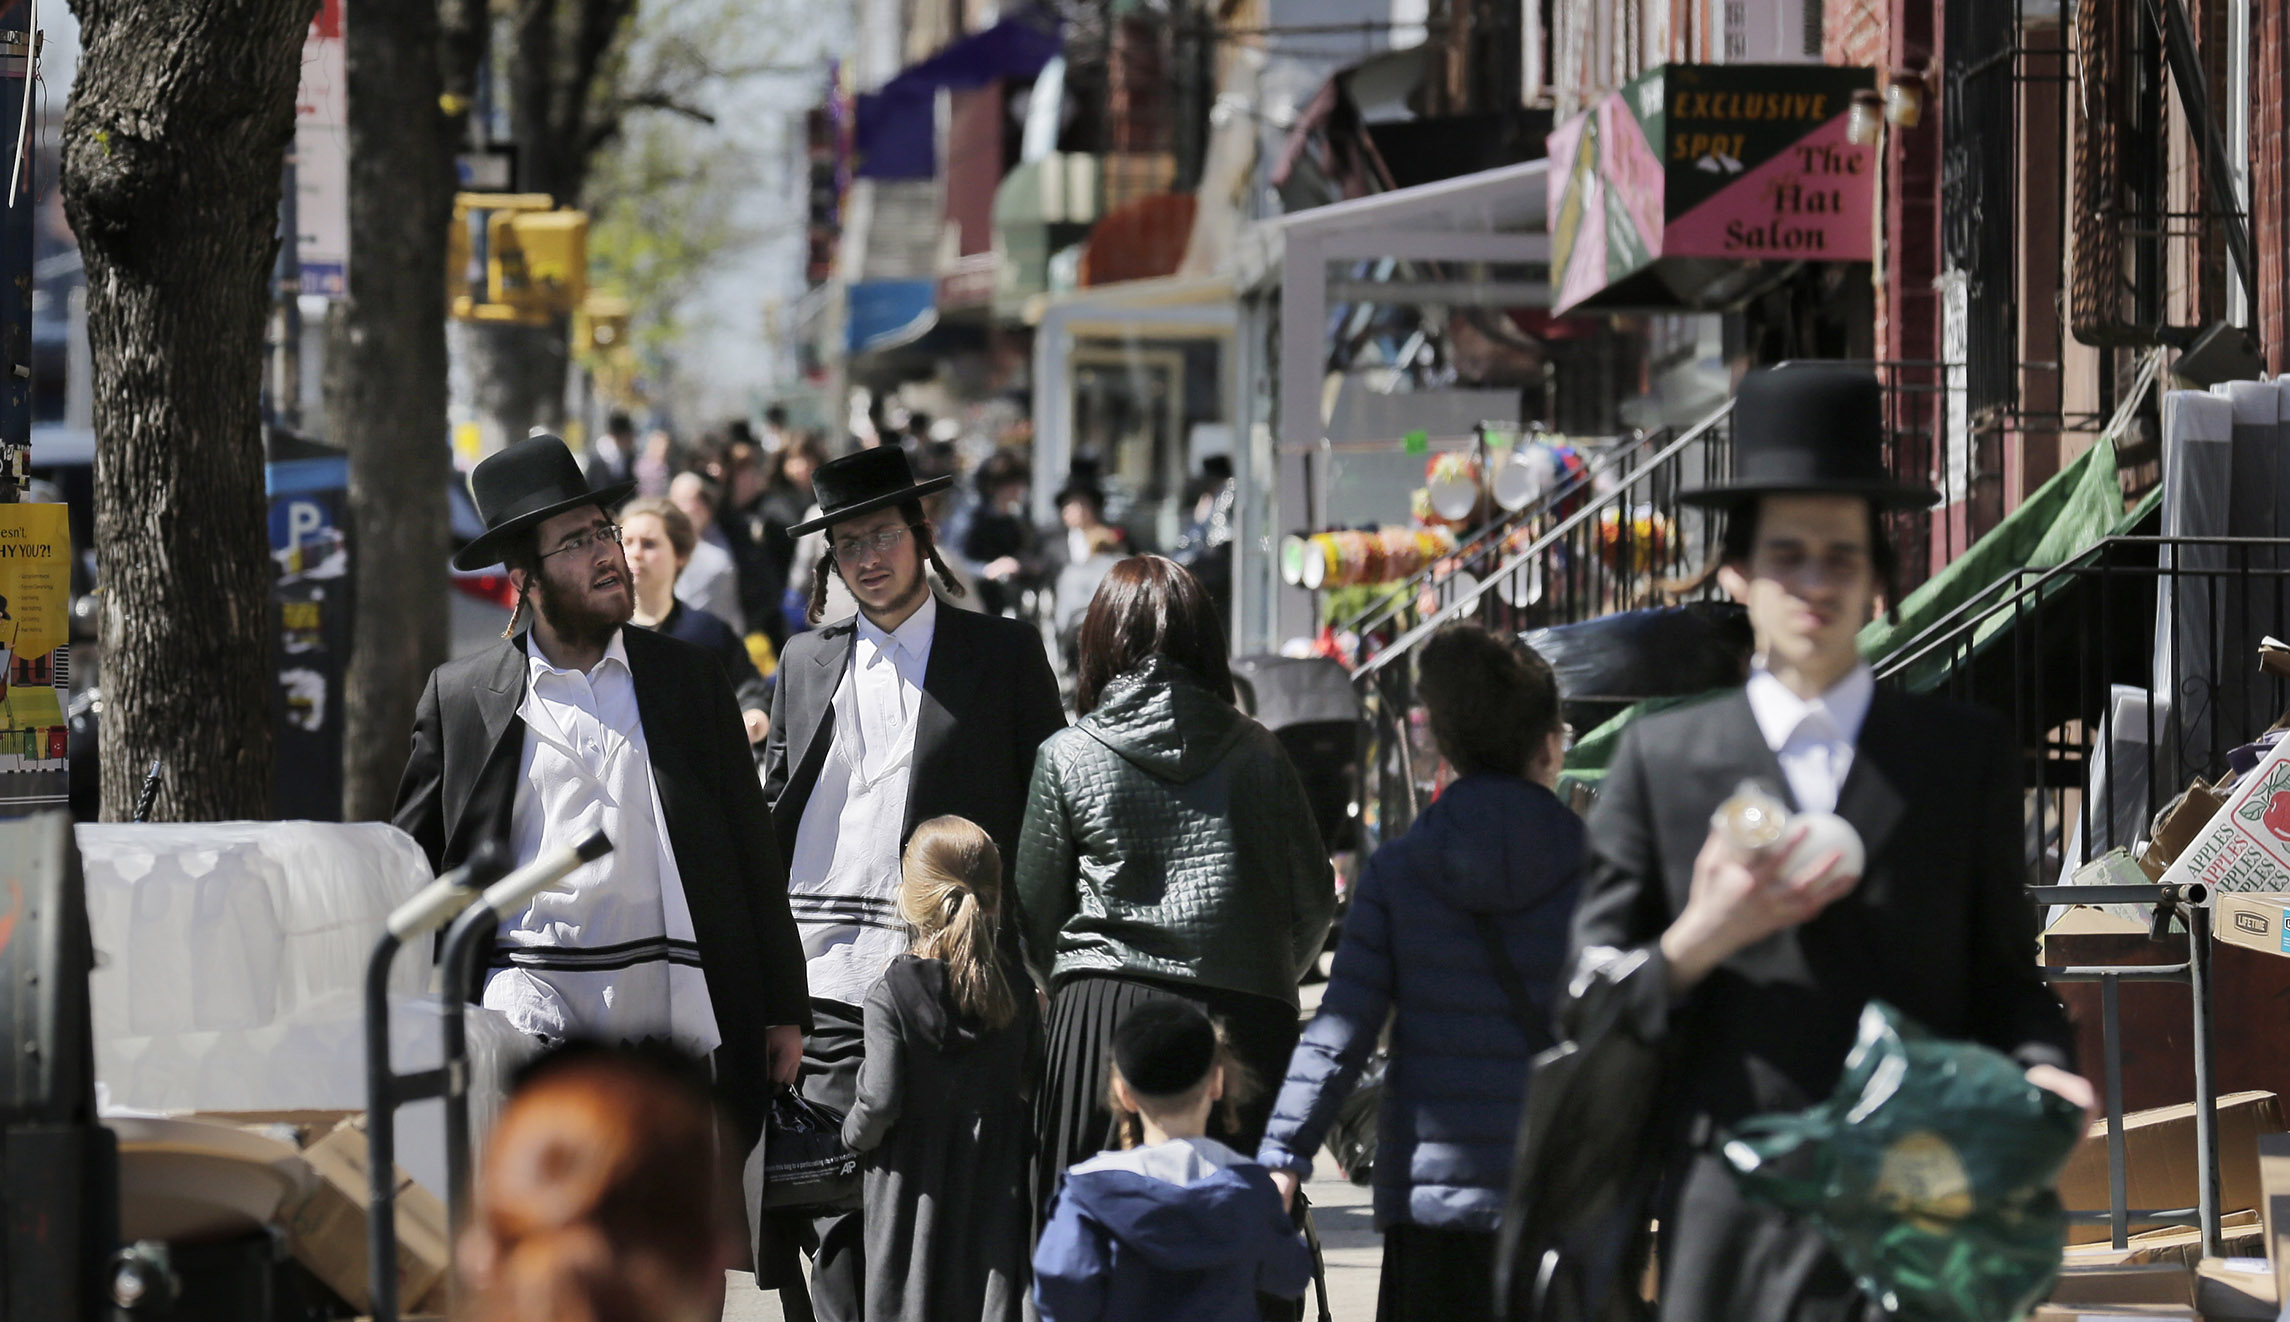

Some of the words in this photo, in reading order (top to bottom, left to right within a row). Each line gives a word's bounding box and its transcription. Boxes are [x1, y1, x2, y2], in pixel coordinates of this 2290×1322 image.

[1673, 91, 1827, 120] EXCLUSIVE
[1672, 132, 1746, 161] SPOT
[1796, 142, 1864, 175] The
[1764, 178, 1842, 214] Hat
[1723, 218, 1825, 251] Salon
[288, 500, 322, 549] P
[19, 543, 51, 558] YOU?!
[2187, 823, 2235, 879] APPLES
[2201, 834, 2249, 890] APPLES
